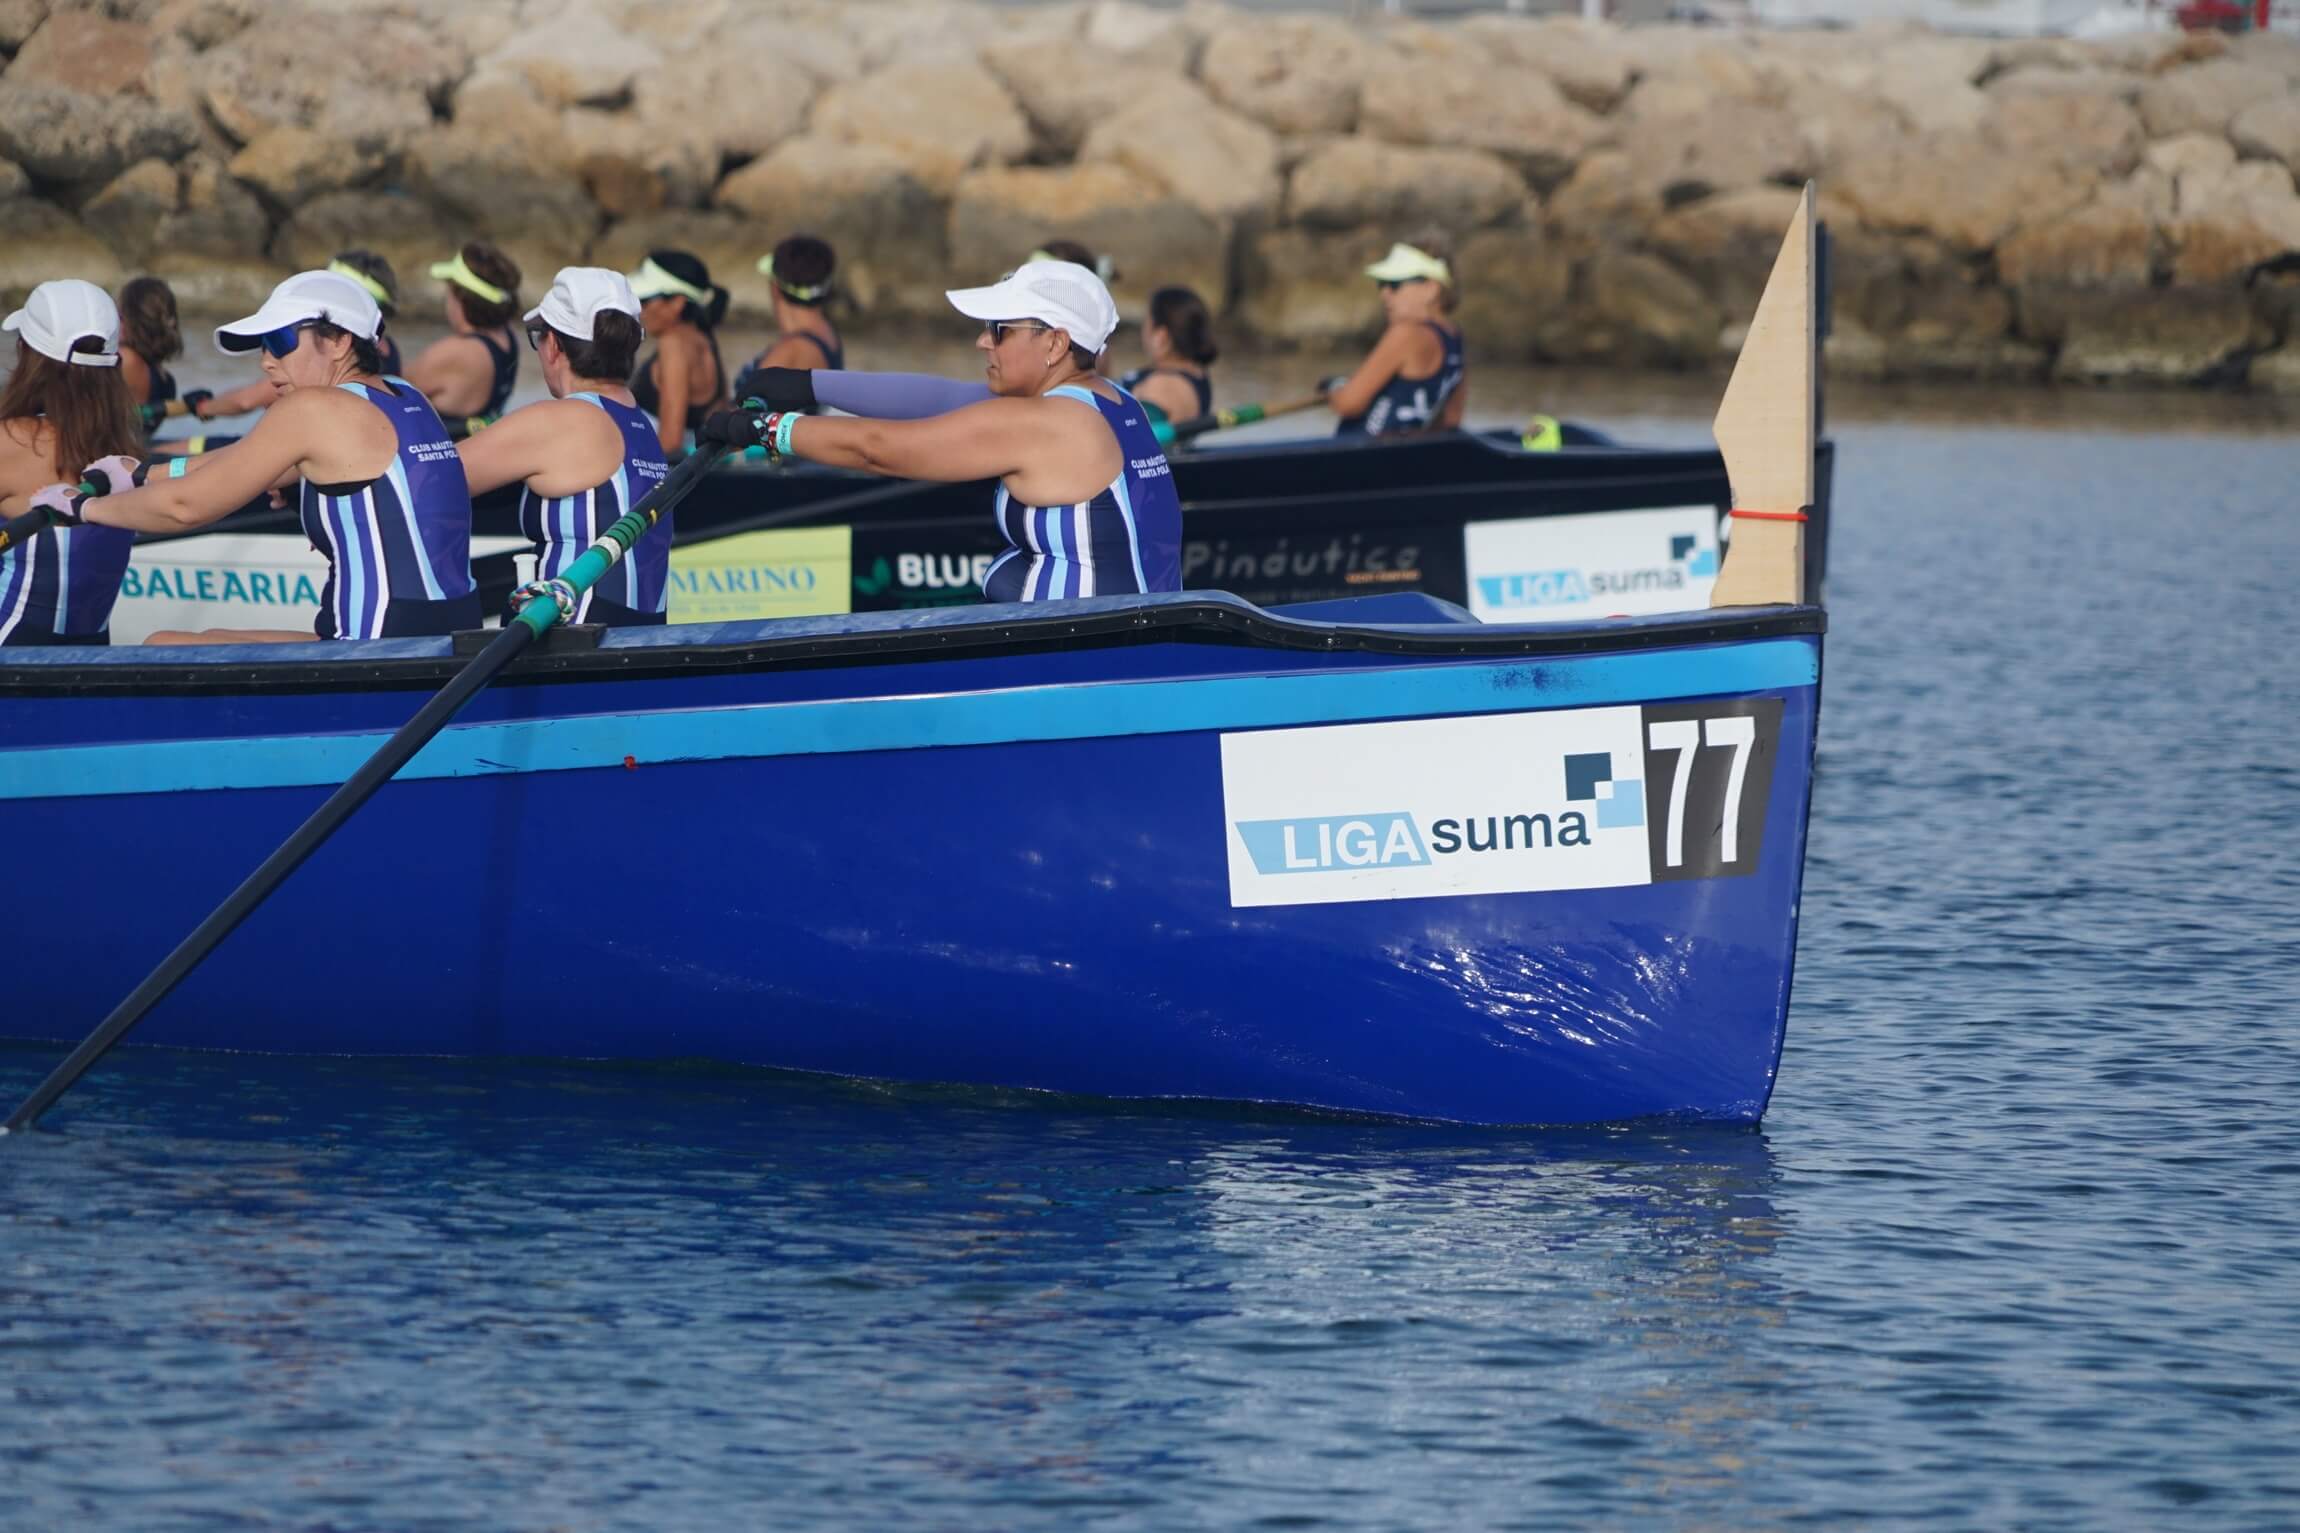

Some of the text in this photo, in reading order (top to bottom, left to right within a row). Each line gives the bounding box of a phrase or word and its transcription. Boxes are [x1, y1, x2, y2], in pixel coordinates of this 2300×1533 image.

[408, 443, 431, 454] CLUB
[418, 452, 444, 462] SANTA
[632, 458, 648, 469] CLUB
[1130, 459, 1147, 469] CLUB
[1138, 467, 1157, 479] SANTA
[1500, 566, 1684, 606] LIGA suma
[1649, 716, 1756, 867] 77
[1283, 808, 1591, 869] LIGA suma
